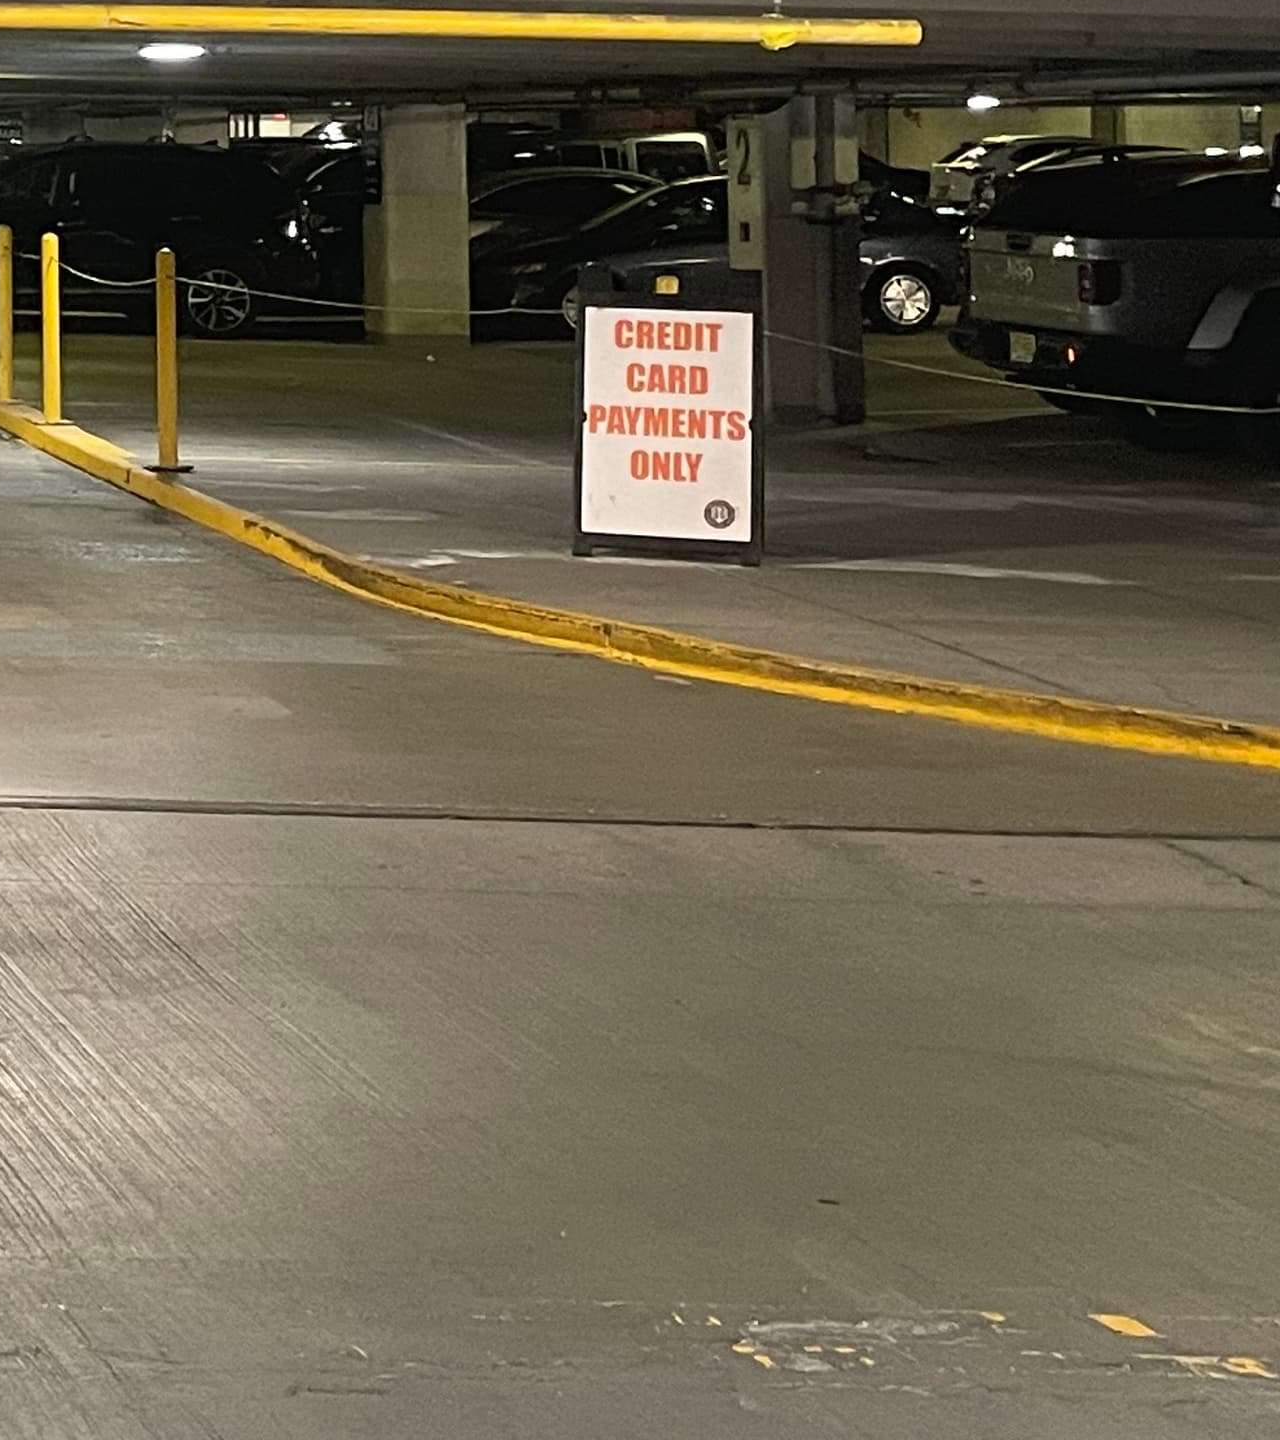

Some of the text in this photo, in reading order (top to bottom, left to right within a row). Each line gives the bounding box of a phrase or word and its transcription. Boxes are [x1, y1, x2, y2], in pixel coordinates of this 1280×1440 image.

[736, 129, 751, 186] 2
[614, 319, 723, 352] CREDIT
[626, 363, 709, 395] CARD
[589, 405, 746, 441] PAYMENTS
[630, 450, 703, 483] ONLY
